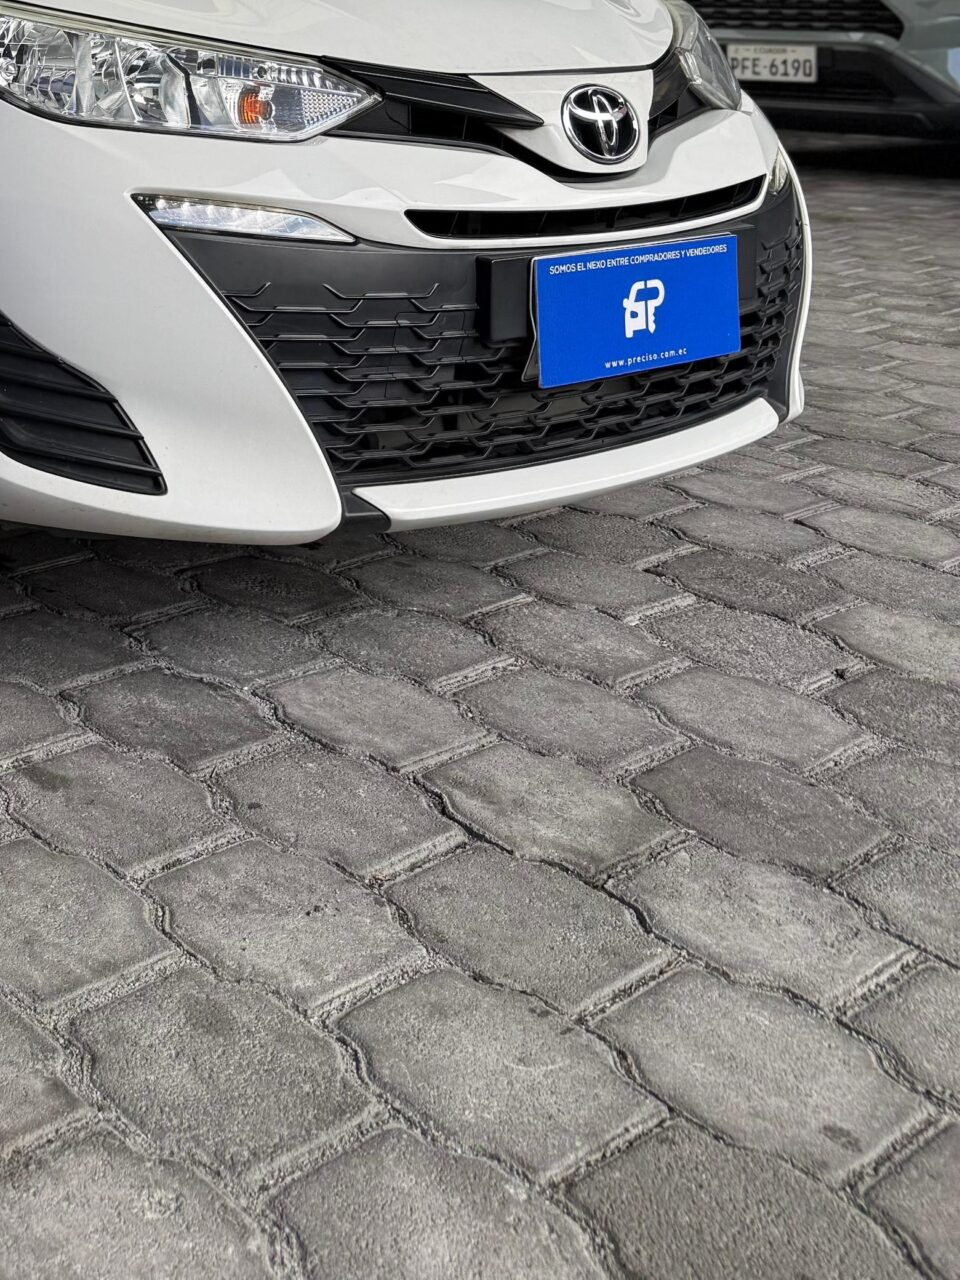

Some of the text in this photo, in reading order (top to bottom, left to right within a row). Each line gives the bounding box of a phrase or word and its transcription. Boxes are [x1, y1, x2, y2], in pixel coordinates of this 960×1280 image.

[549, 244, 727, 275] SOMOS EL NEXO ENTRE COMPRADORES Y VENDEDORES
[604, 347, 687, 369] www.preciso.com.ec
